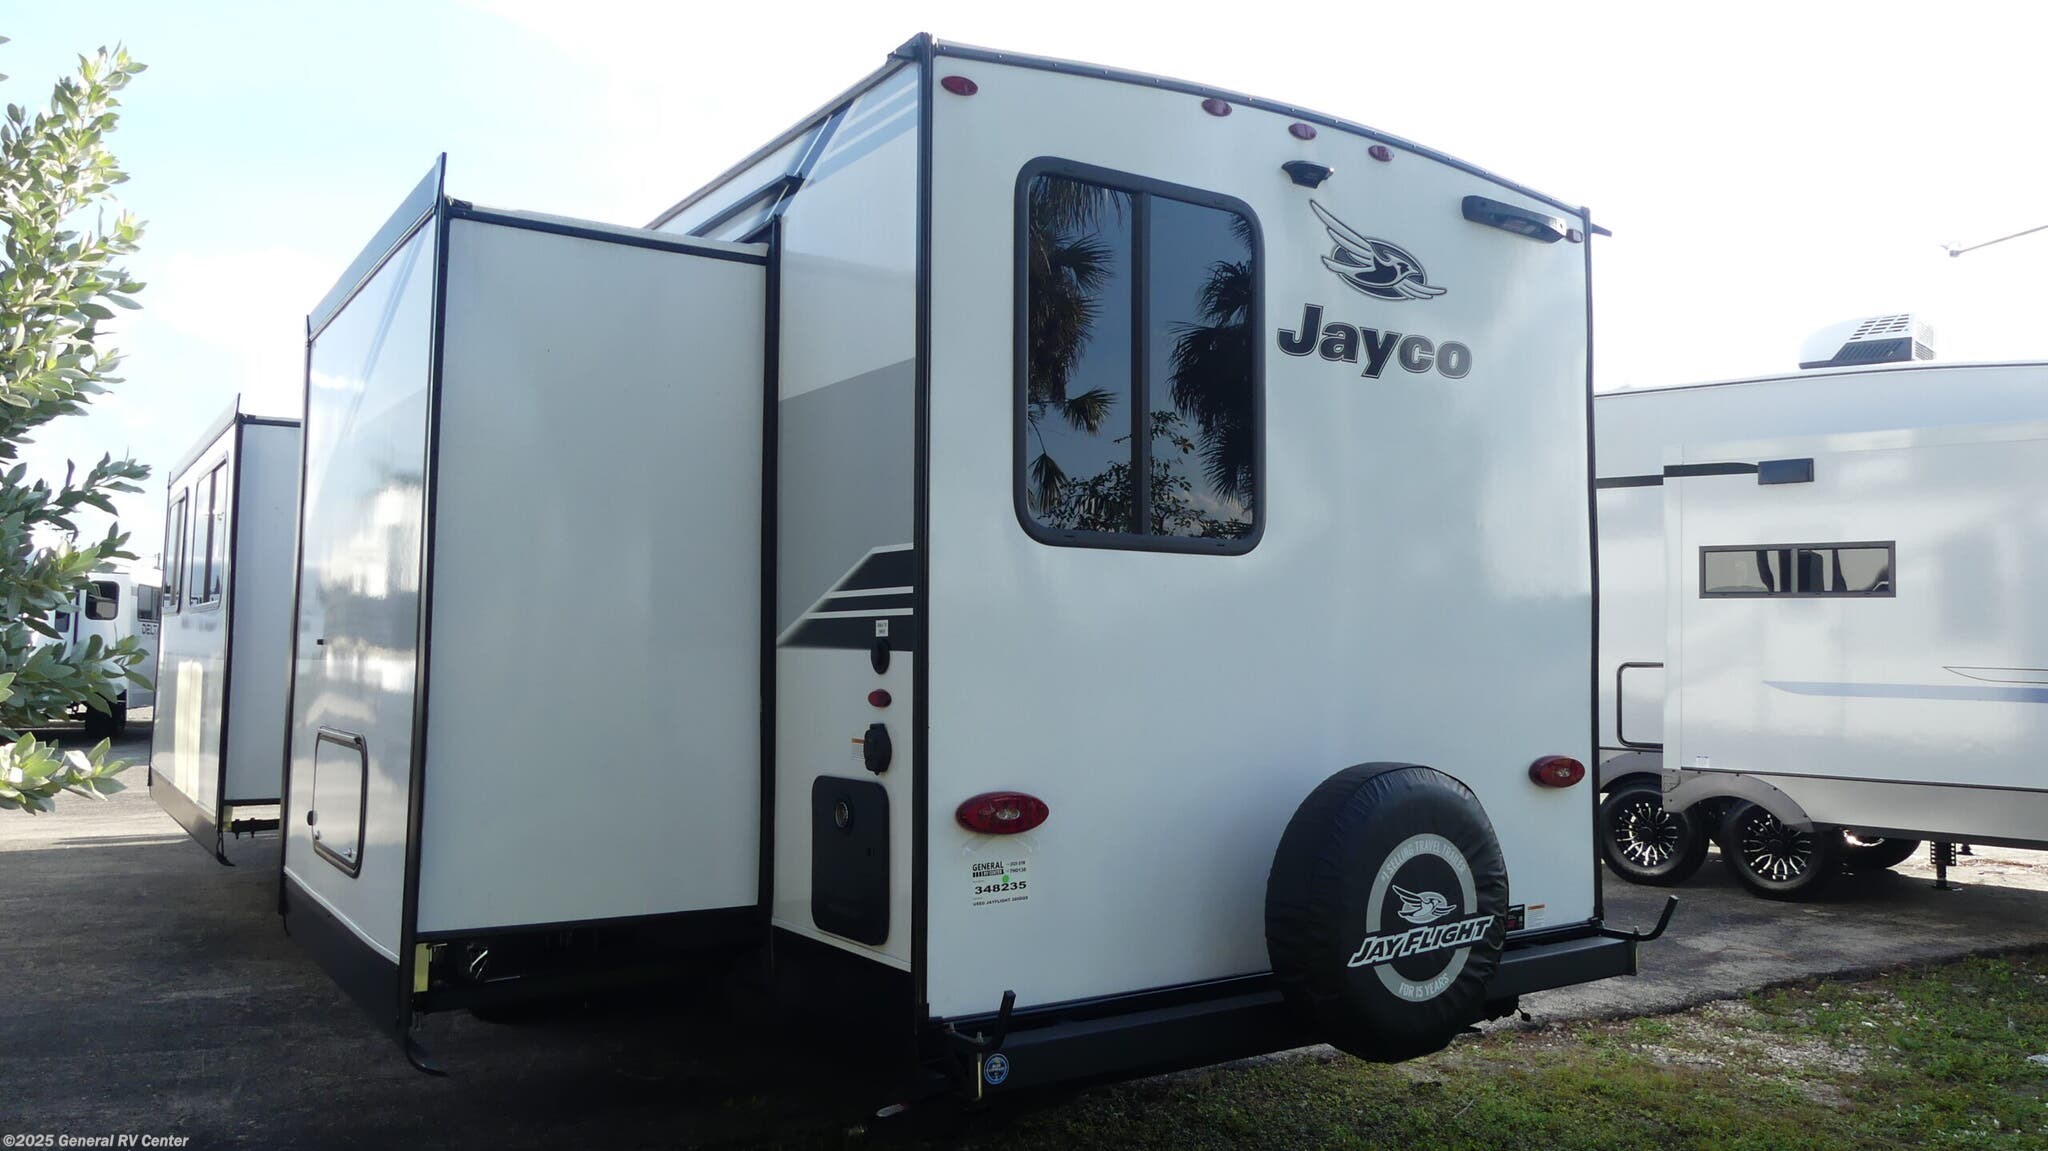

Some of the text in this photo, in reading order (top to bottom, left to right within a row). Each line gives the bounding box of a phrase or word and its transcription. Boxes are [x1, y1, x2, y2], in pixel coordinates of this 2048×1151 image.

[1277, 303, 1472, 379] Jayco
[1415, 839, 1441, 853] TRAVEL
[972, 861, 1004, 872] GENERAL
[975, 881, 1027, 894] 348235
[1399, 982, 1414, 997] FOR
[1425, 972, 1449, 996] YEARS
